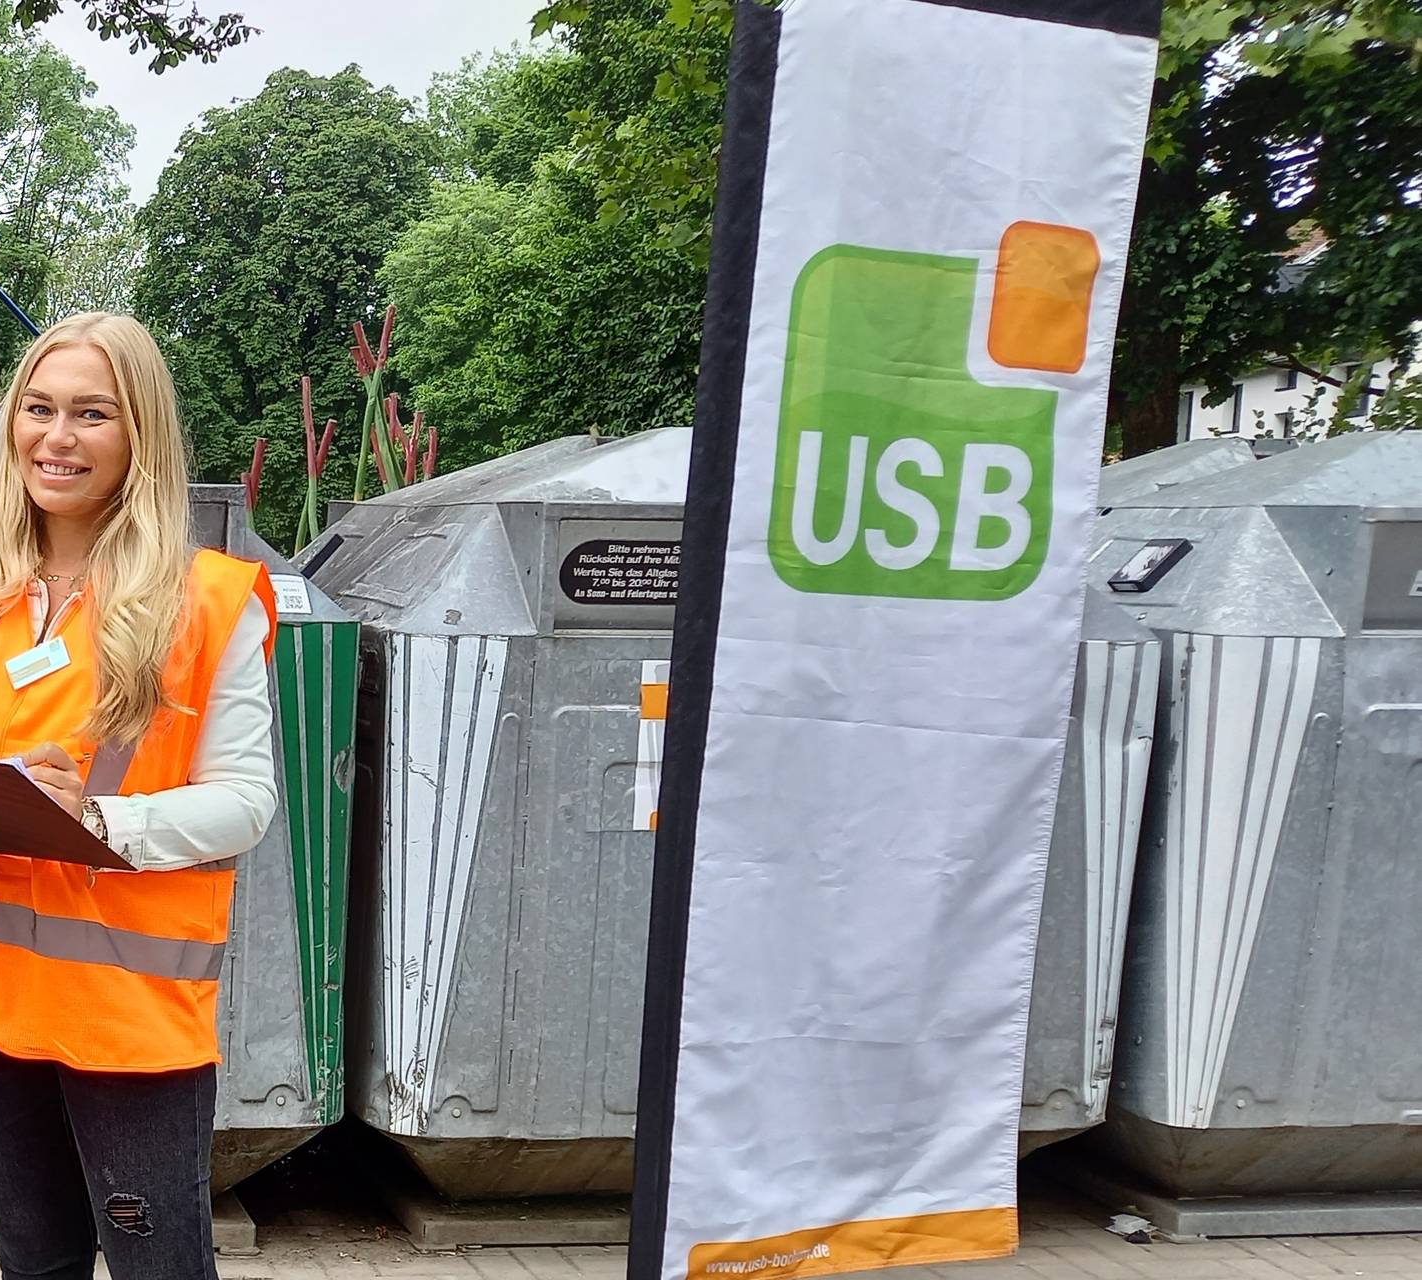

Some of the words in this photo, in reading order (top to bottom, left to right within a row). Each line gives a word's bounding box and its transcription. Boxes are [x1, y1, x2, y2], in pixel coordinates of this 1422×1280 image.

[790, 430, 1033, 572] USB
[608, 544, 631, 554] Bitte
[632, 545, 671, 554] nehmen
[579, 554, 624, 564] Rücksicht
[626, 555, 642, 564] auf
[643, 555, 662, 564] Ihre
[573, 567, 606, 577] Werfen
[608, 568, 623, 577] Sie
[625, 568, 643, 577] das
[645, 568, 678, 579] Altglas
[611, 578, 626, 587] bis
[653, 579, 671, 587] Uhr
[610, 589, 625, 597] und
